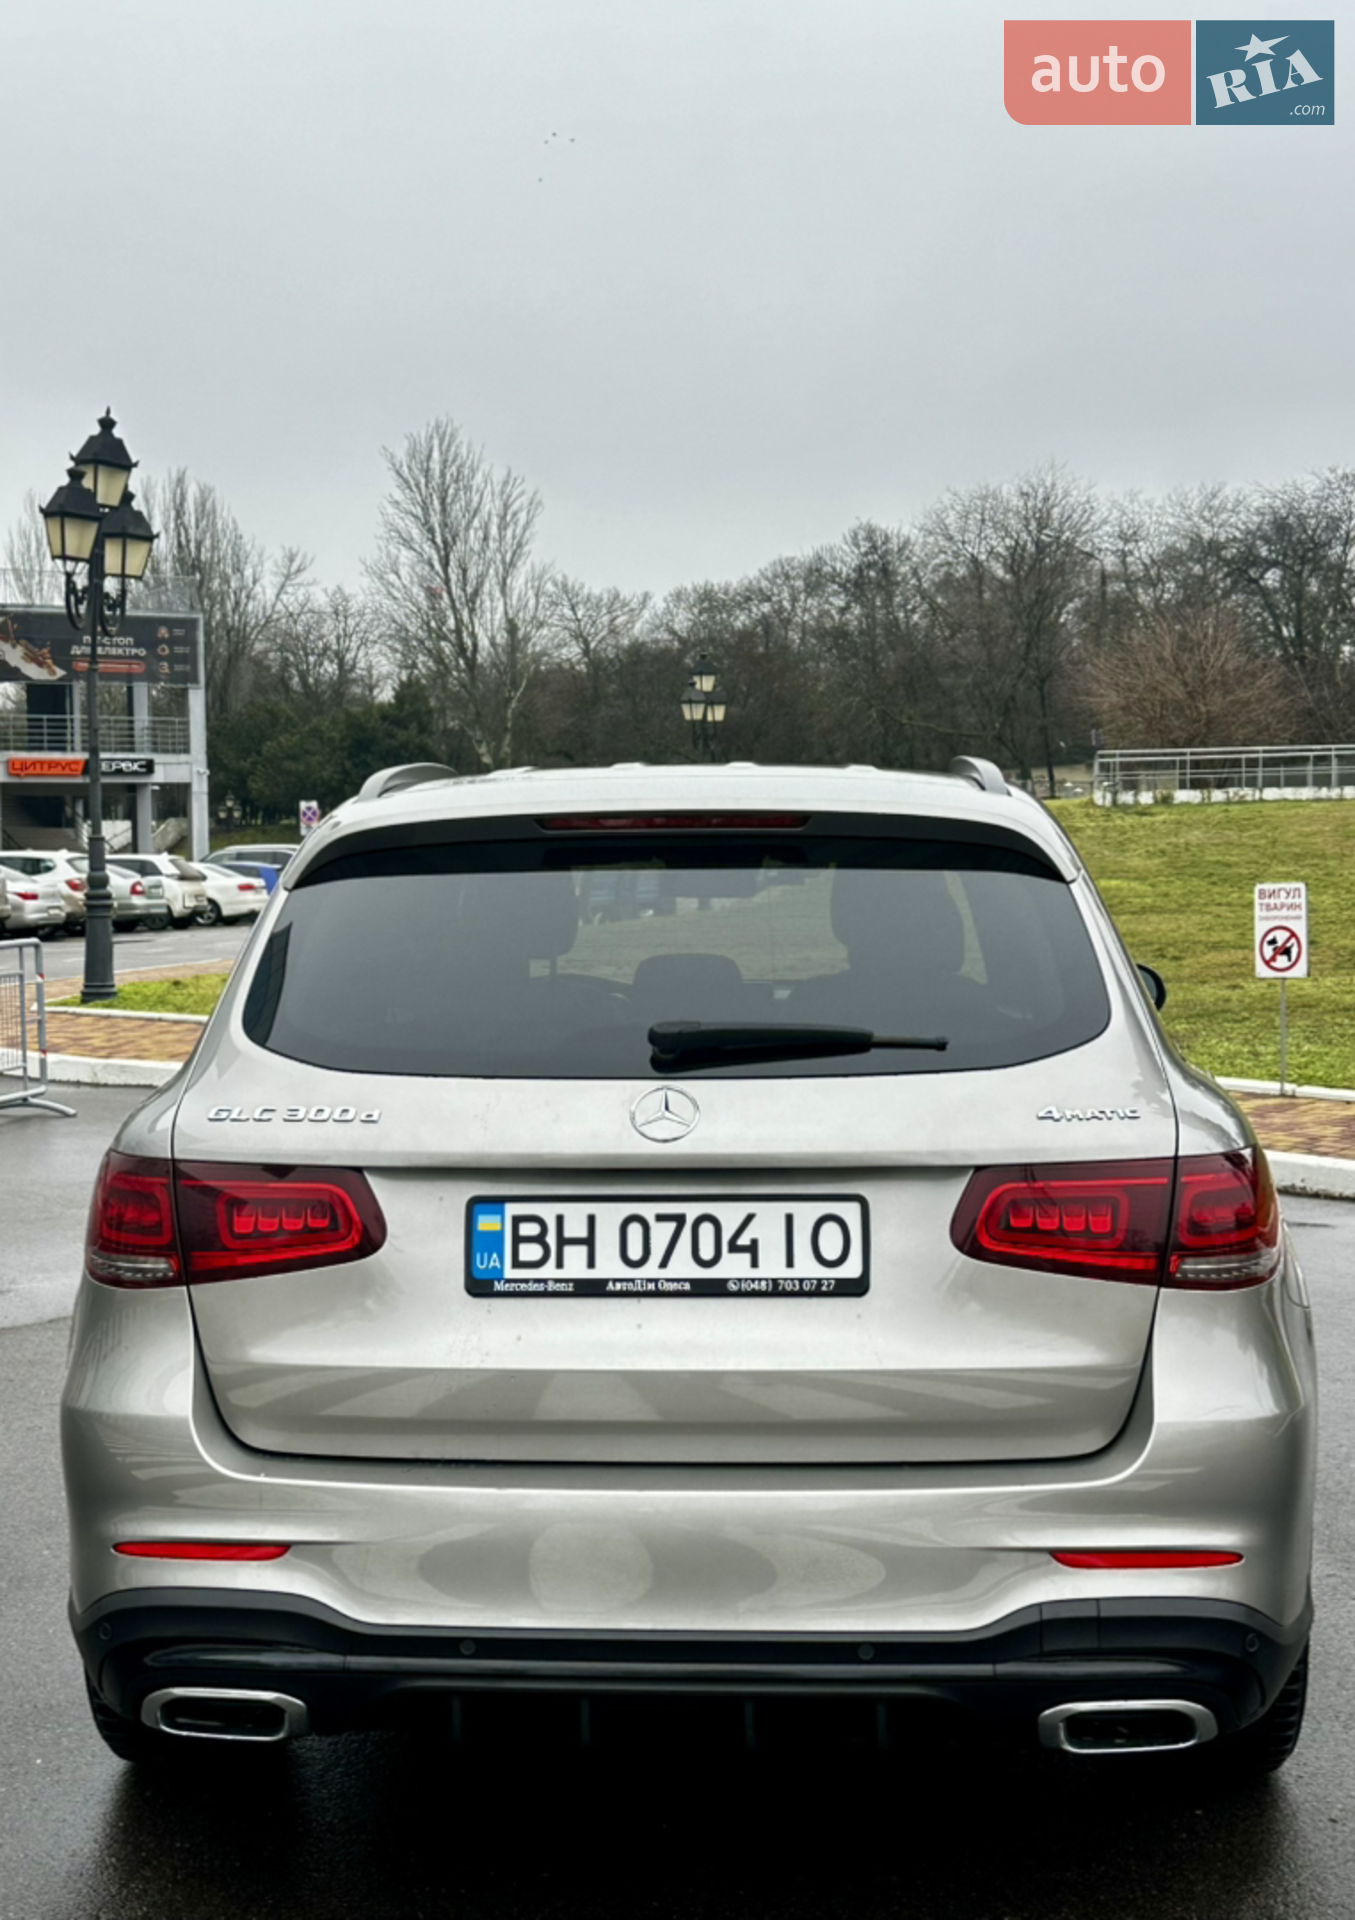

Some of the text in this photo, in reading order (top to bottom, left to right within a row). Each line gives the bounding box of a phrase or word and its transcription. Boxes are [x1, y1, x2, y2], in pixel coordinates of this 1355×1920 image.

[11, 760, 148, 772] ЦИТРУС ЕРВІС
[1258, 887, 1302, 900] ВИГУЛ
[1258, 902, 1303, 912] ТВАРИН
[207, 1105, 277, 1122] GLC
[1037, 1106, 1141, 1122] 4MATIC
[511, 1212, 853, 1270] BH 0704 IO
[476, 1252, 502, 1270] UA
[493, 1280, 574, 1292] Mercedes-Benz
[740, 1279, 836, 1292] (048) 703 07 27
